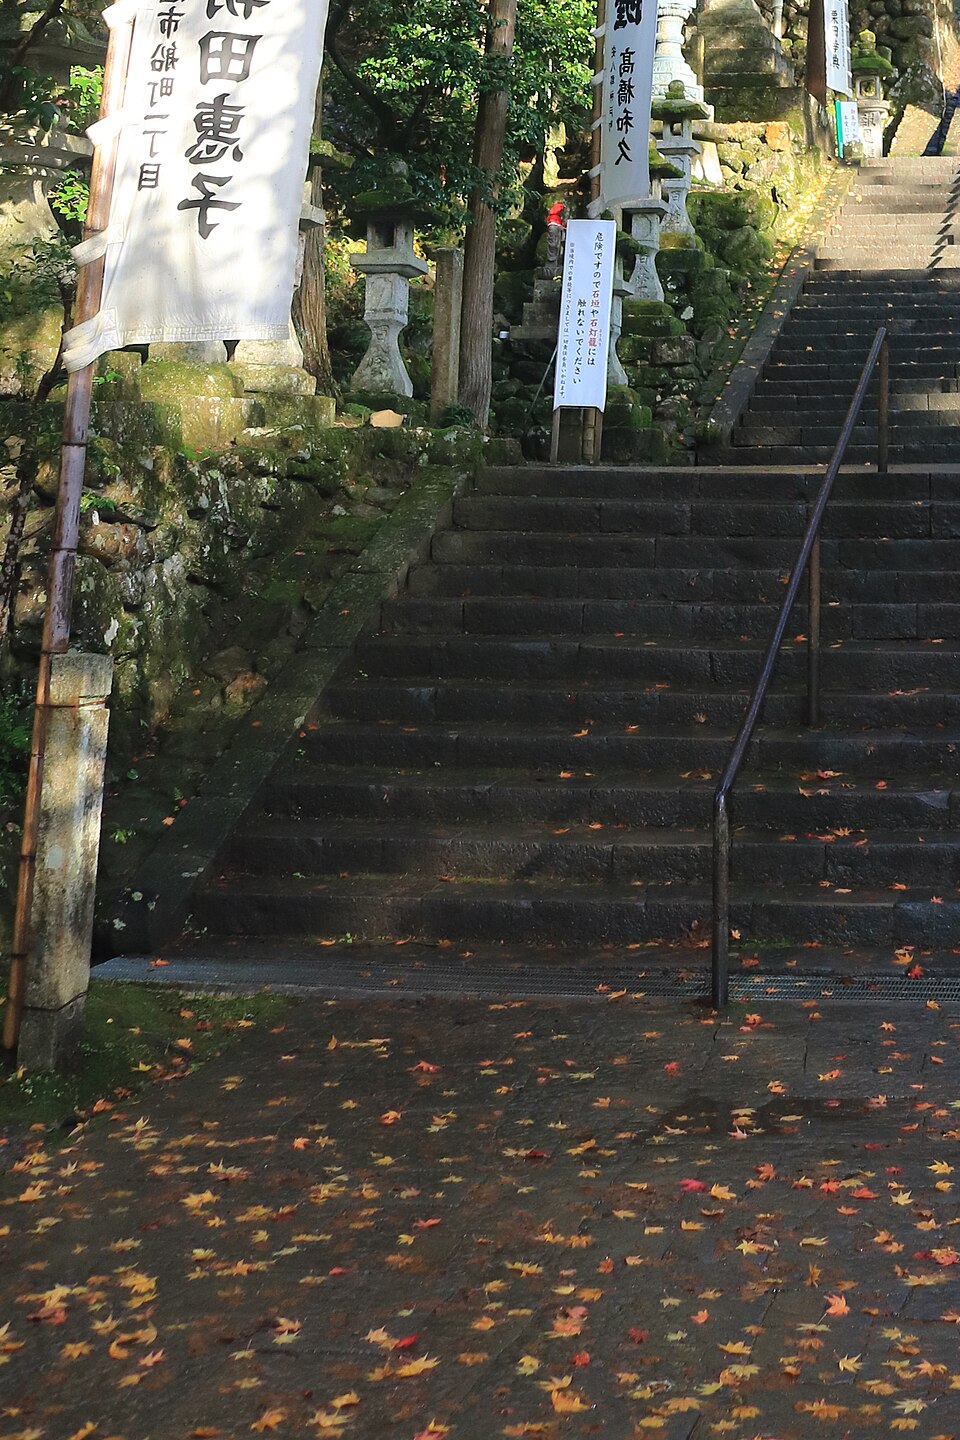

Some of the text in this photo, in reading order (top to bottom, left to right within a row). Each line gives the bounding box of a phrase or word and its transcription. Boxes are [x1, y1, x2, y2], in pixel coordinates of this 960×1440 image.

[573, 298, 587, 385] 触れないでください
